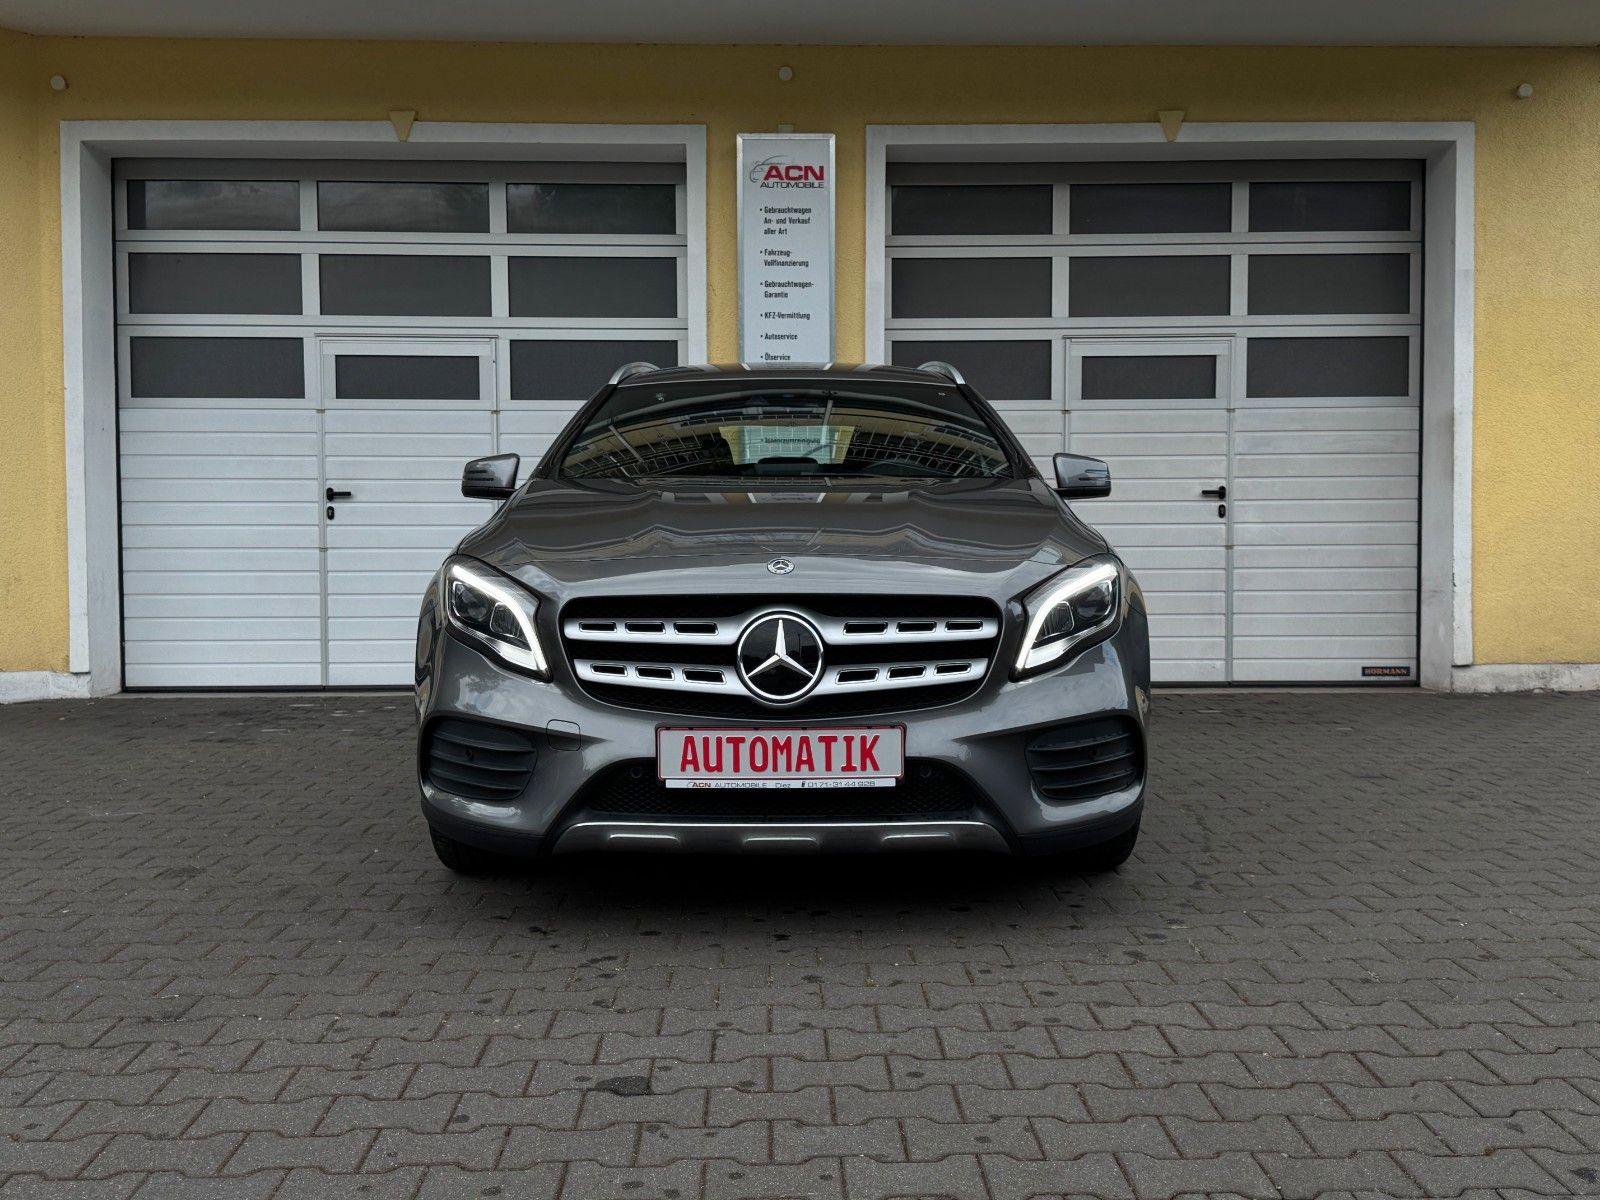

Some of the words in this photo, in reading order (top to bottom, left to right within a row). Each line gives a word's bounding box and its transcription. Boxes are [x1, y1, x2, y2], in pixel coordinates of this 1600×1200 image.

[763, 165, 824, 181] ACN
[764, 206, 812, 214] Gebrauchtwagen
[764, 248, 792, 257] Fahrzeug-
[764, 280, 814, 288] Gebrauchtwagen-
[764, 312, 810, 320] KFZ-Vermittlung
[764, 352, 790, 360] Ölservice
[680, 735, 880, 773] AUTOMATIK
